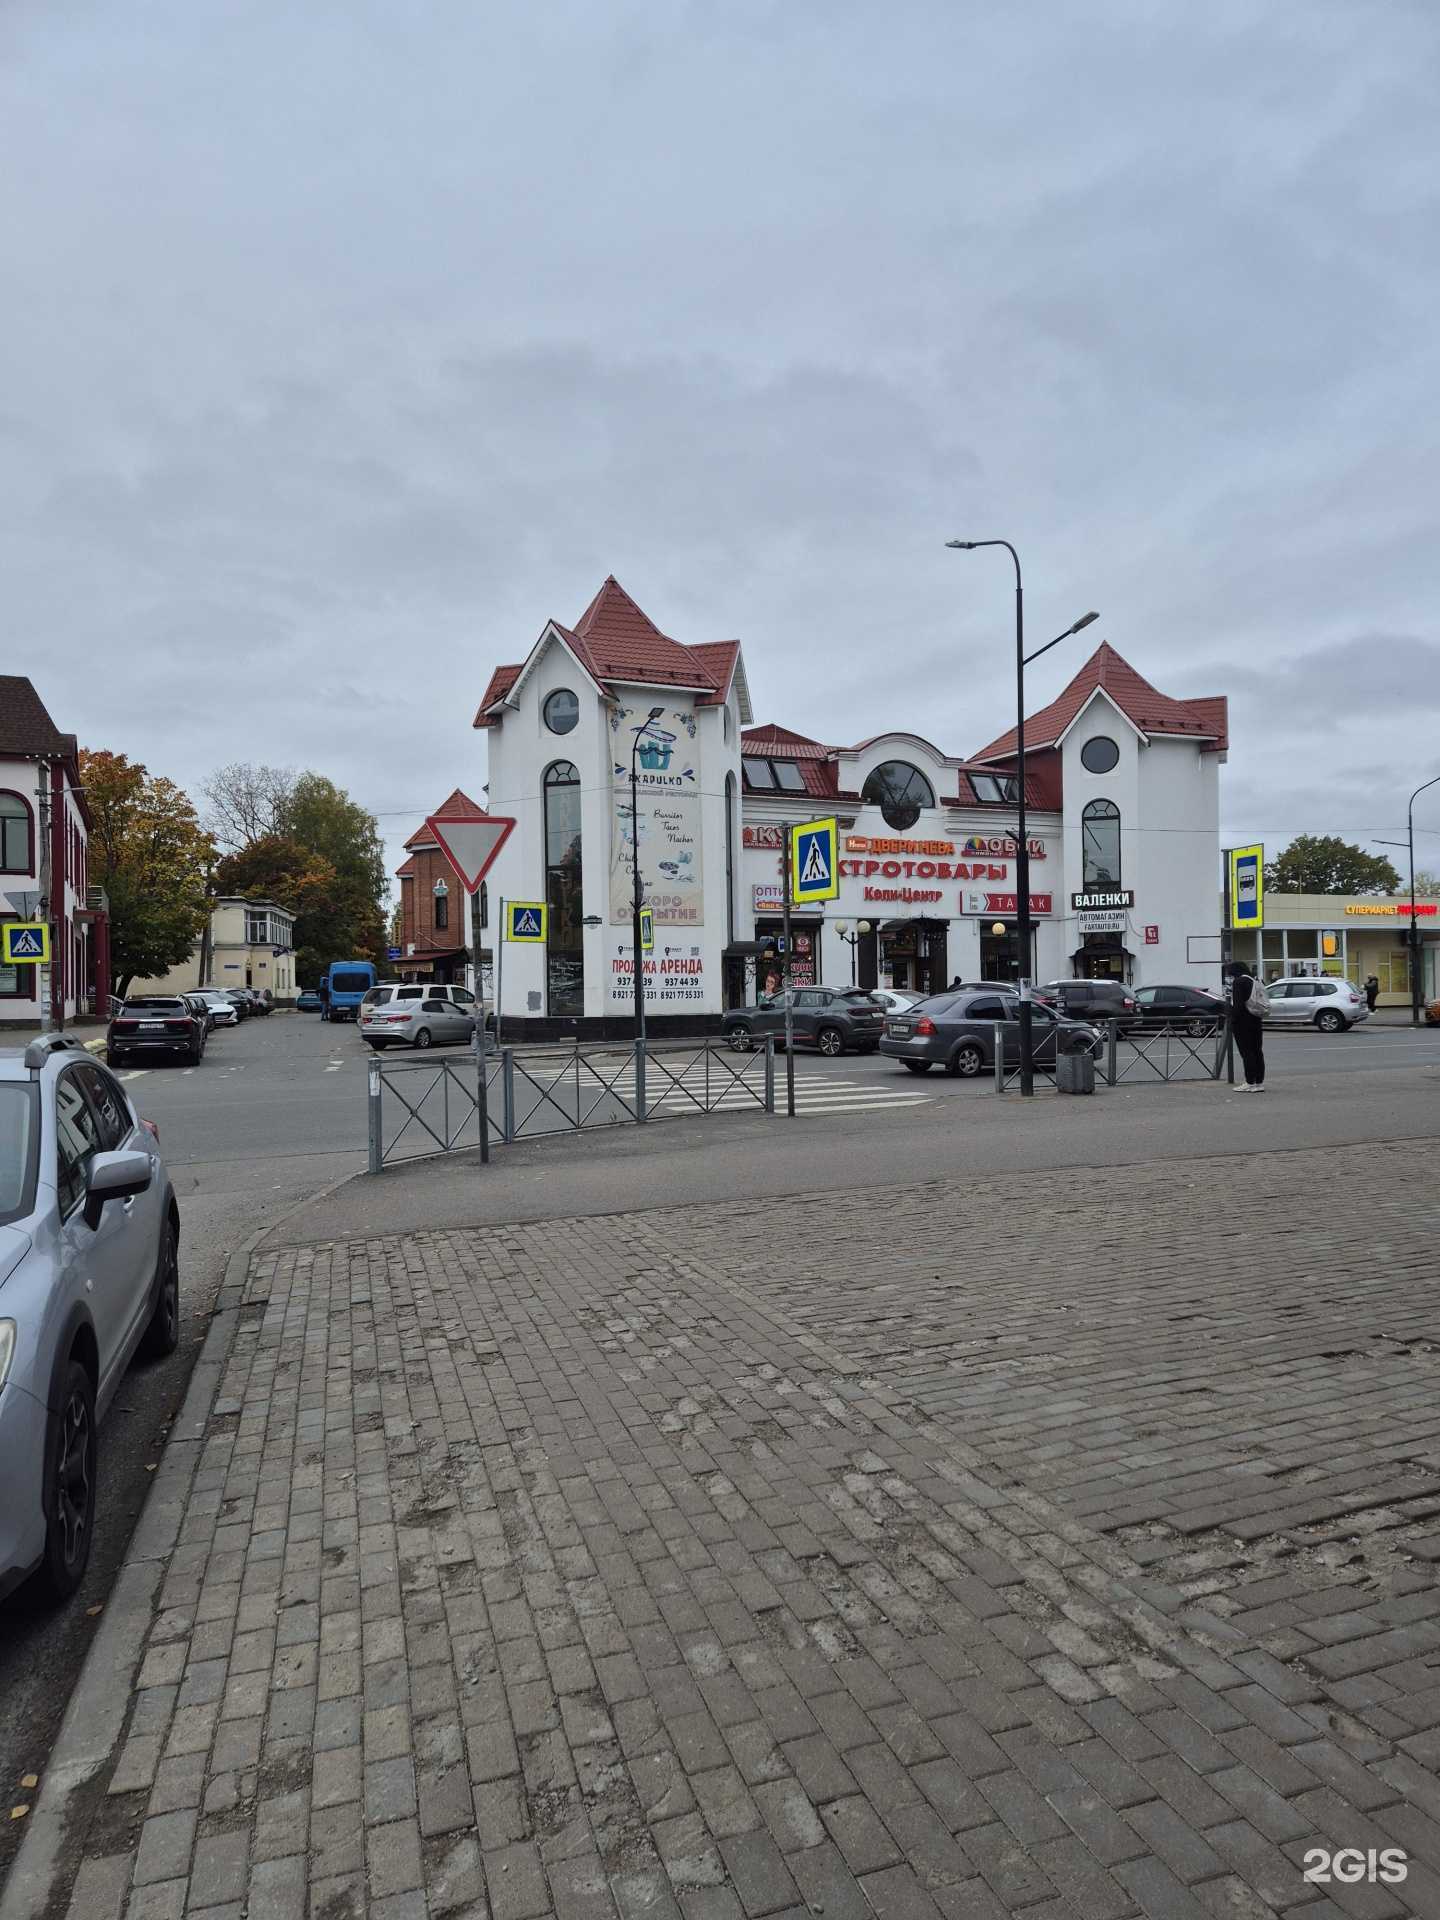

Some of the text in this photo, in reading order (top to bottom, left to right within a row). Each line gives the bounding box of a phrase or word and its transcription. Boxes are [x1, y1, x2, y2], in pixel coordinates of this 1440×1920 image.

[653, 809, 683, 820] Burritos
[662, 821, 680, 831] Tacos
[667, 833, 694, 843] Nachos
[988, 838, 1045, 853] ОБИ
[996, 897, 1046, 909] ТААК
[1075, 892, 1130, 907] ВАЛЕНКИ
[1079, 911, 1125, 922] АВТОМАГАЗИН
[612, 959, 657, 974] ПРОДЖА
[660, 959, 703, 975] АРЕНДА
[617, 977, 631, 986] 937
[664, 977, 699, 986] 937 44 39
[617, 990, 628, 999] 921
[646, 991, 657, 1000] 331
[665, 991, 676, 1000] 921
